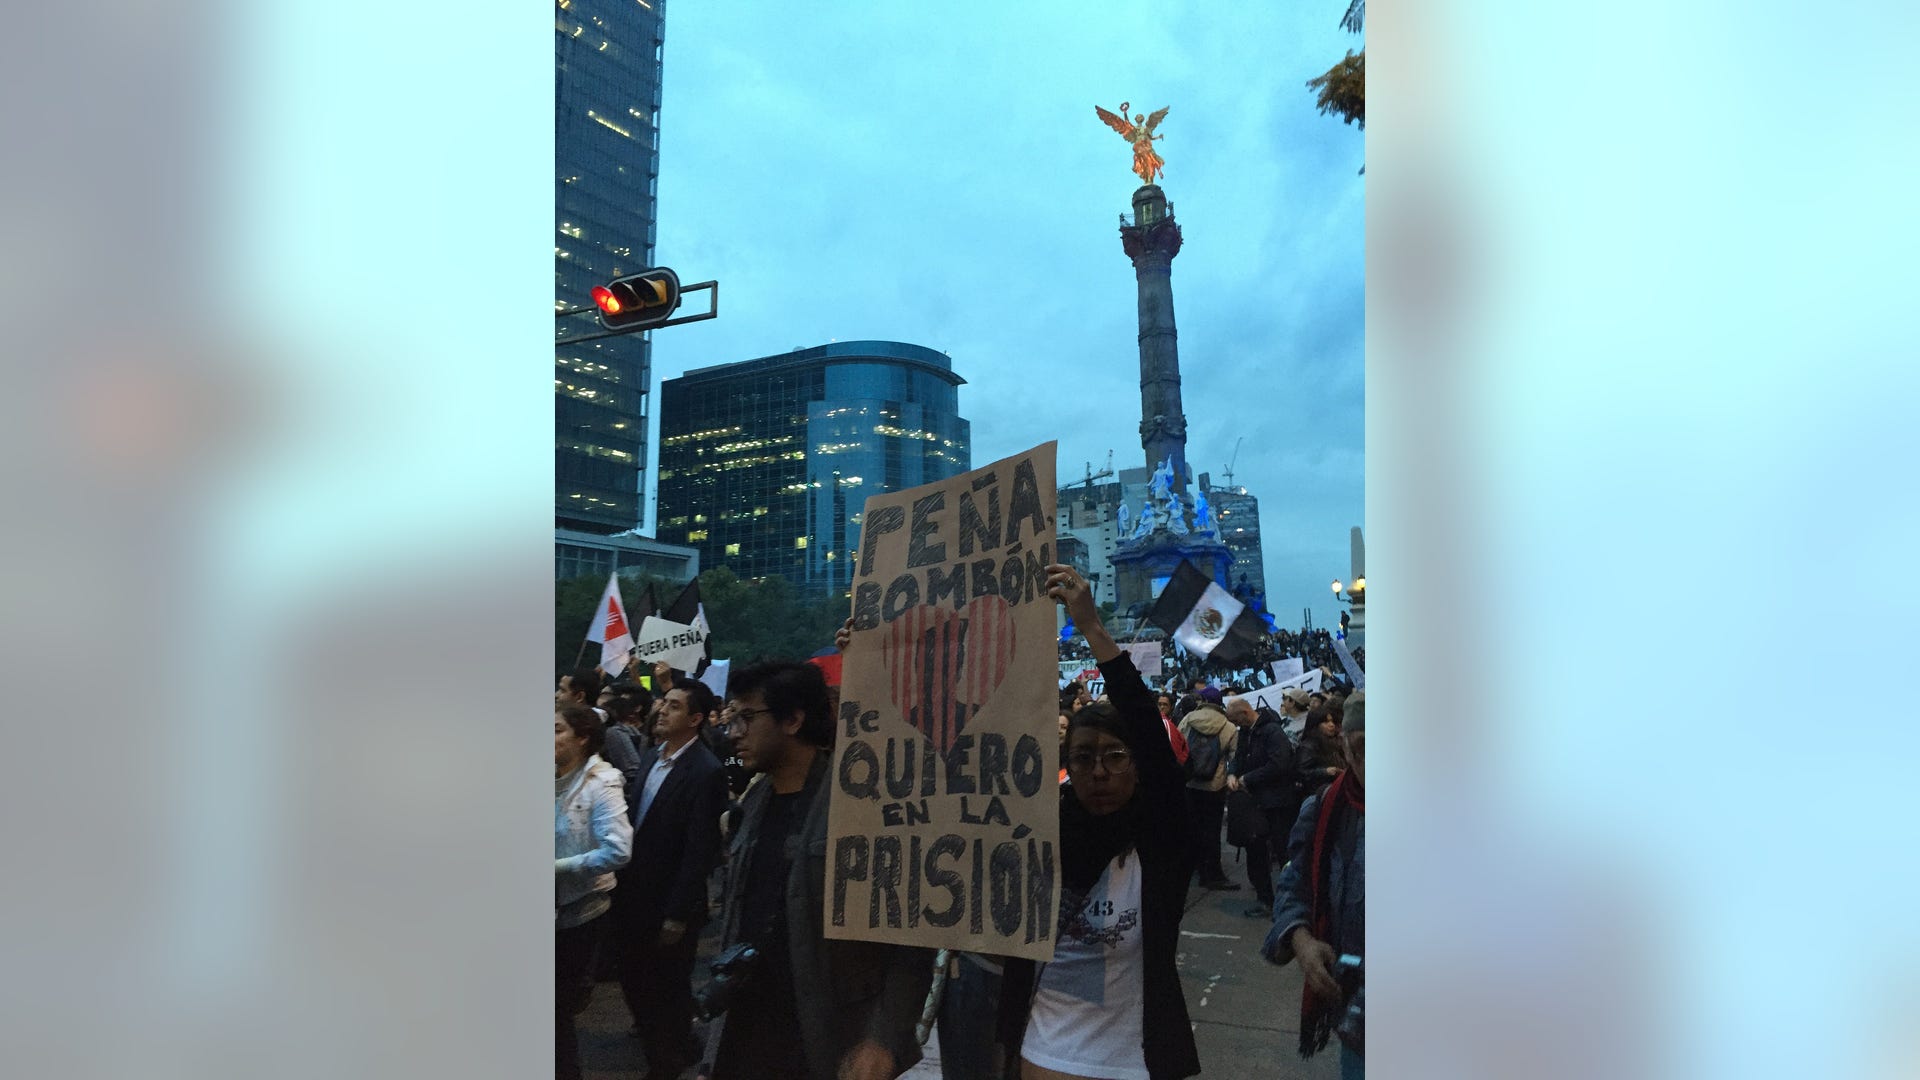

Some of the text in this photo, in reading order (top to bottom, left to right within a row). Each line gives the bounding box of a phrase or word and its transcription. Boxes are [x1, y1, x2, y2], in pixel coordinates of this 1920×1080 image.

[852, 542, 1050, 632] BOMBÓN
[638, 629, 703, 657] FUERA PEÑA
[839, 732, 1043, 804] QUIERO
[882, 796, 1011, 827] EN LA
[832, 824, 1053, 945] PRISIÓN
[1088, 900, 1114, 917] 43
